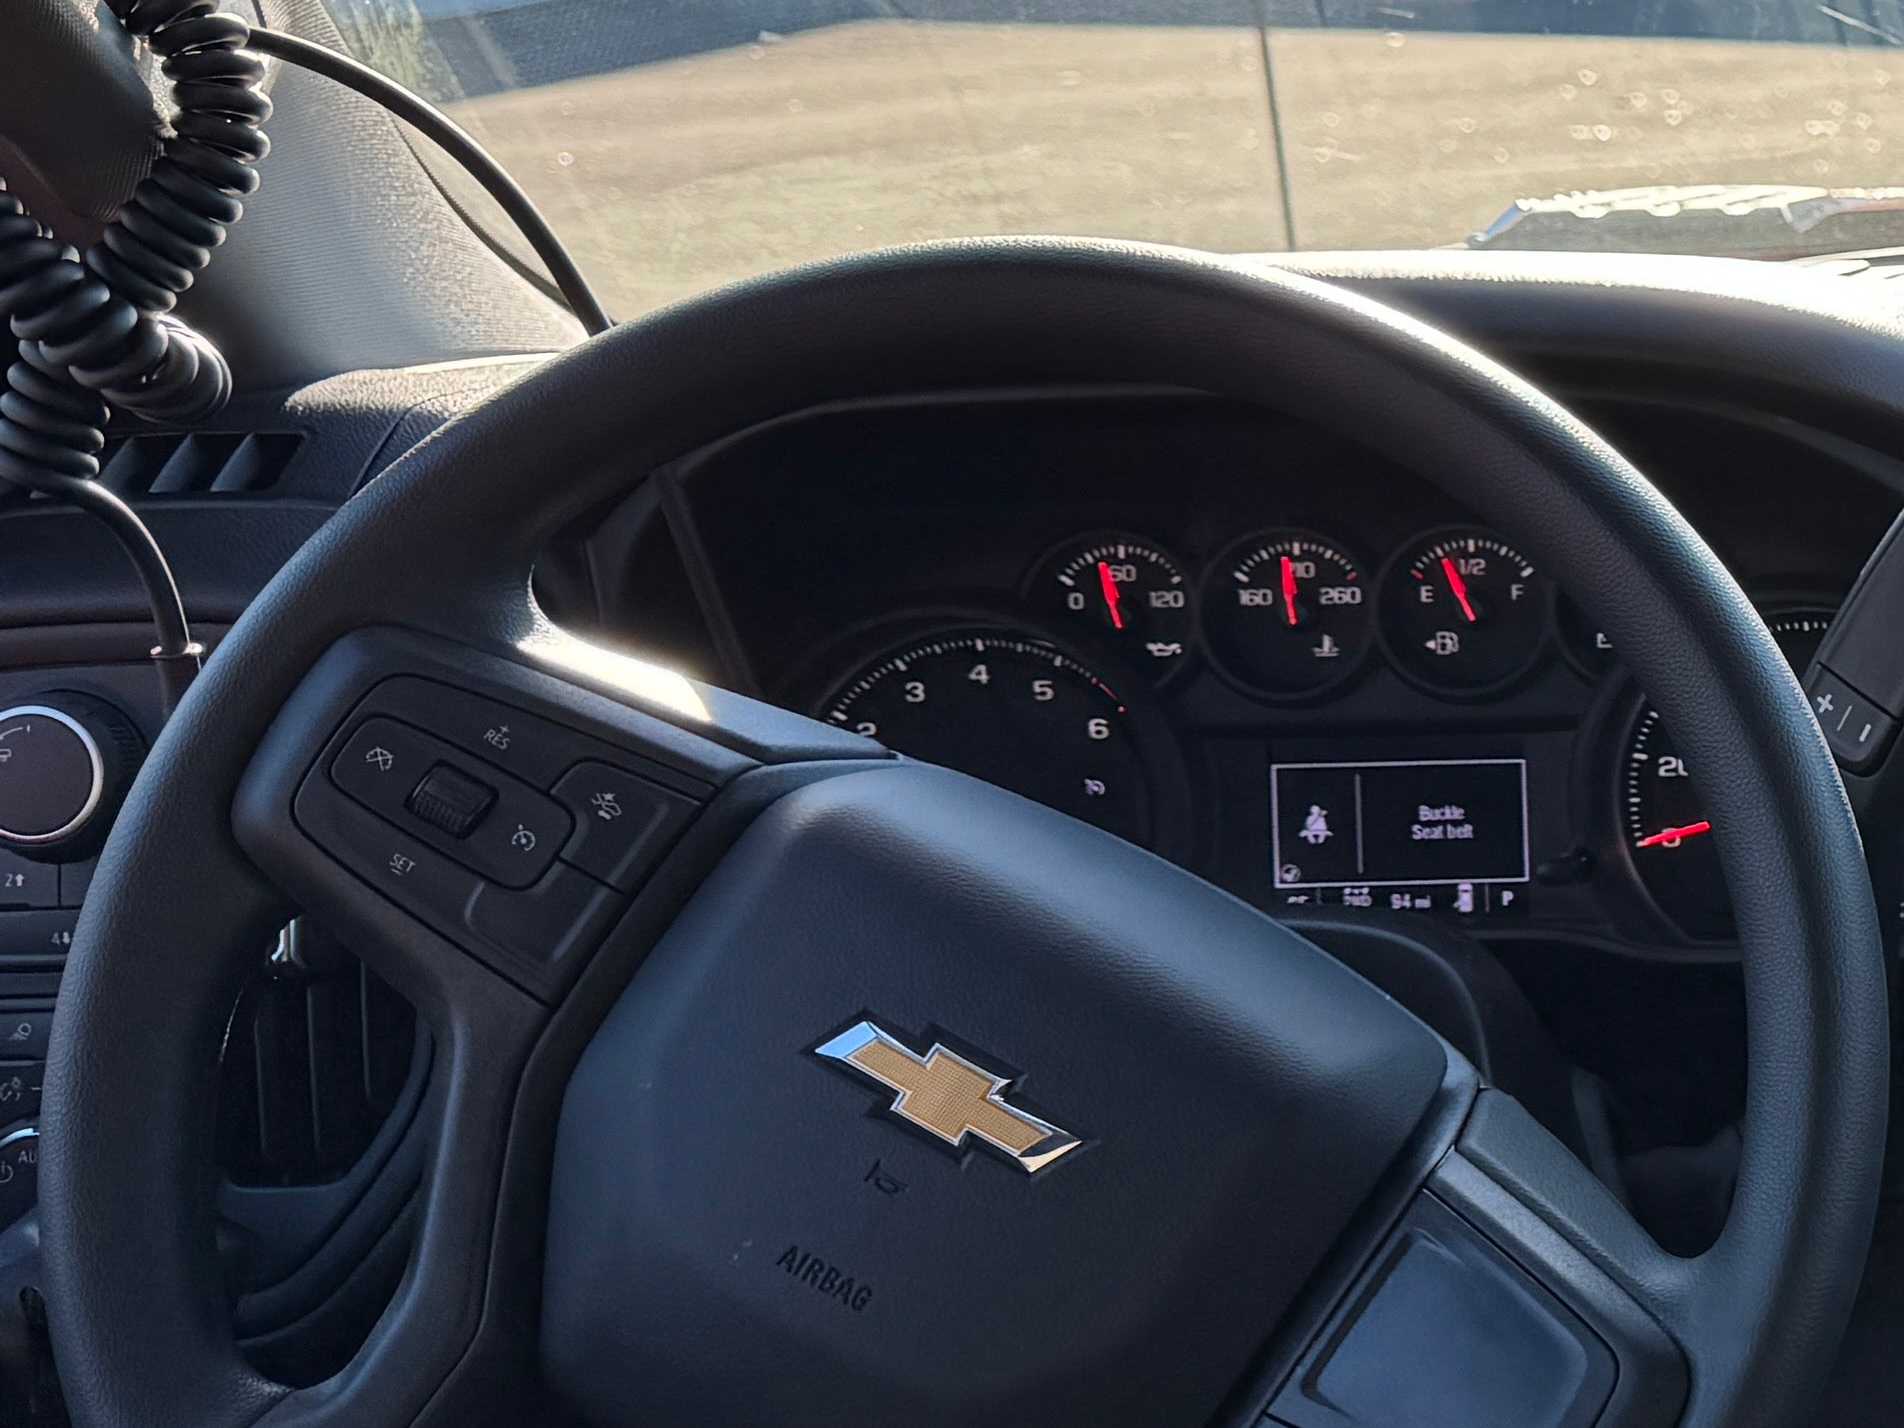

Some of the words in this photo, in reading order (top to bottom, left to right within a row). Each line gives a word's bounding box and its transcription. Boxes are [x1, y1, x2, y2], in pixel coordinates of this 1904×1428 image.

[1458, 557, 1487, 577] 1/2
[1066, 591, 1086, 610] 0
[1148, 590, 1185, 609] 120
[1238, 588, 1273, 607] 160
[1319, 587, 1362, 605] 260
[1420, 585, 1435, 603] E
[1510, 584, 1525, 601] F
[968, 664, 991, 685] 4
[904, 681, 926, 703] 3
[1031, 679, 1055, 701] 5
[1087, 718, 1110, 740] 6
[483, 729, 511, 750] RES
[1410, 824, 1444, 840] Seat
[1446, 823, 1475, 840] belt
[389, 853, 416, 873] SET
[1502, 890, 1515, 907] P
[775, 1244, 874, 1312] AIRBAG
